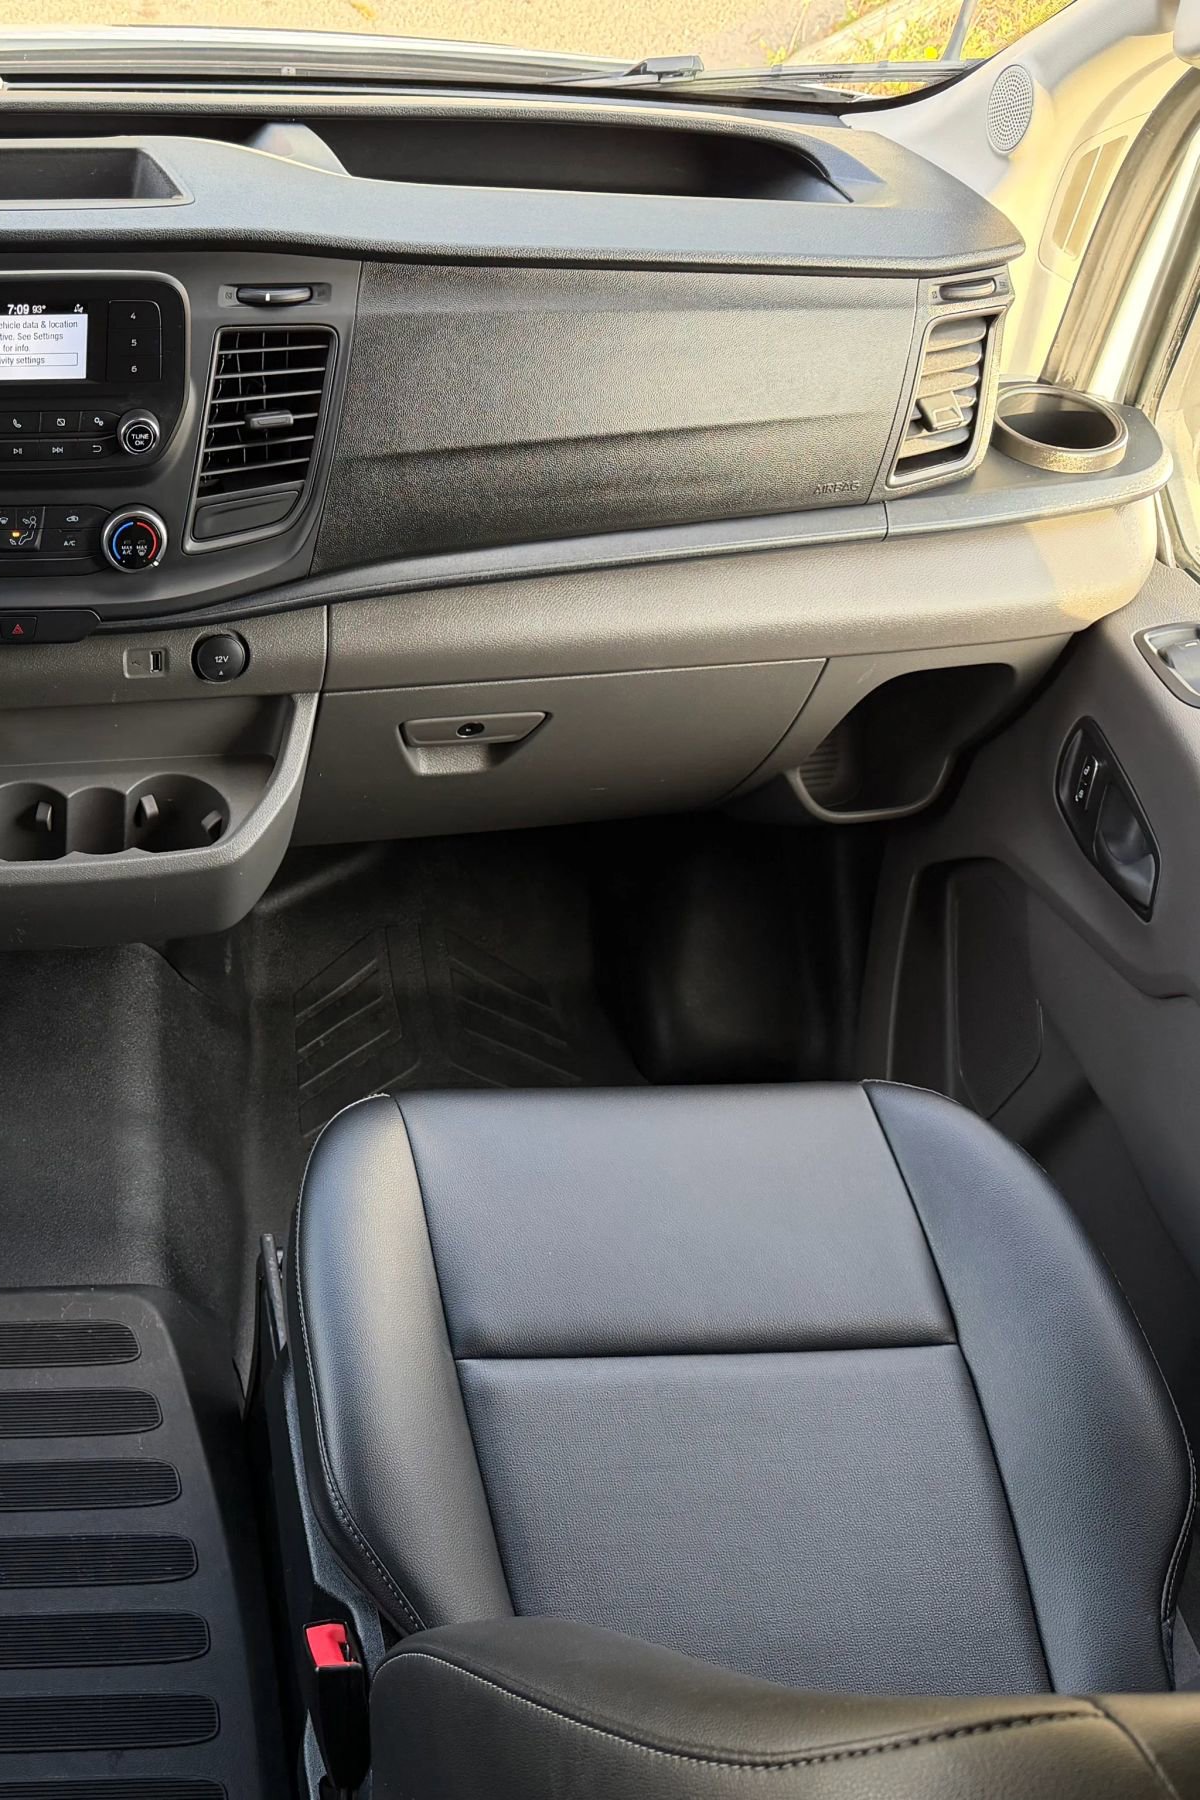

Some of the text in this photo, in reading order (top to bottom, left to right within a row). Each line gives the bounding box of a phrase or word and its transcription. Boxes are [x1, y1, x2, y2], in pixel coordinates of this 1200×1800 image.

[7, 303, 29, 315] 7:09
[130, 312, 137, 320] 4
[22, 320, 39, 329] data
[41, 320, 46, 329] &
[48, 320, 78, 329] location
[17, 332, 31, 341] See
[33, 332, 64, 341] Settings
[131, 339, 138, 347] 5
[2, 344, 13, 352] for
[16, 357, 45, 365] settings
[131, 365, 138, 373] 6
[812, 481, 860, 495] AIRBAG
[214, 655, 229, 663] 12V
